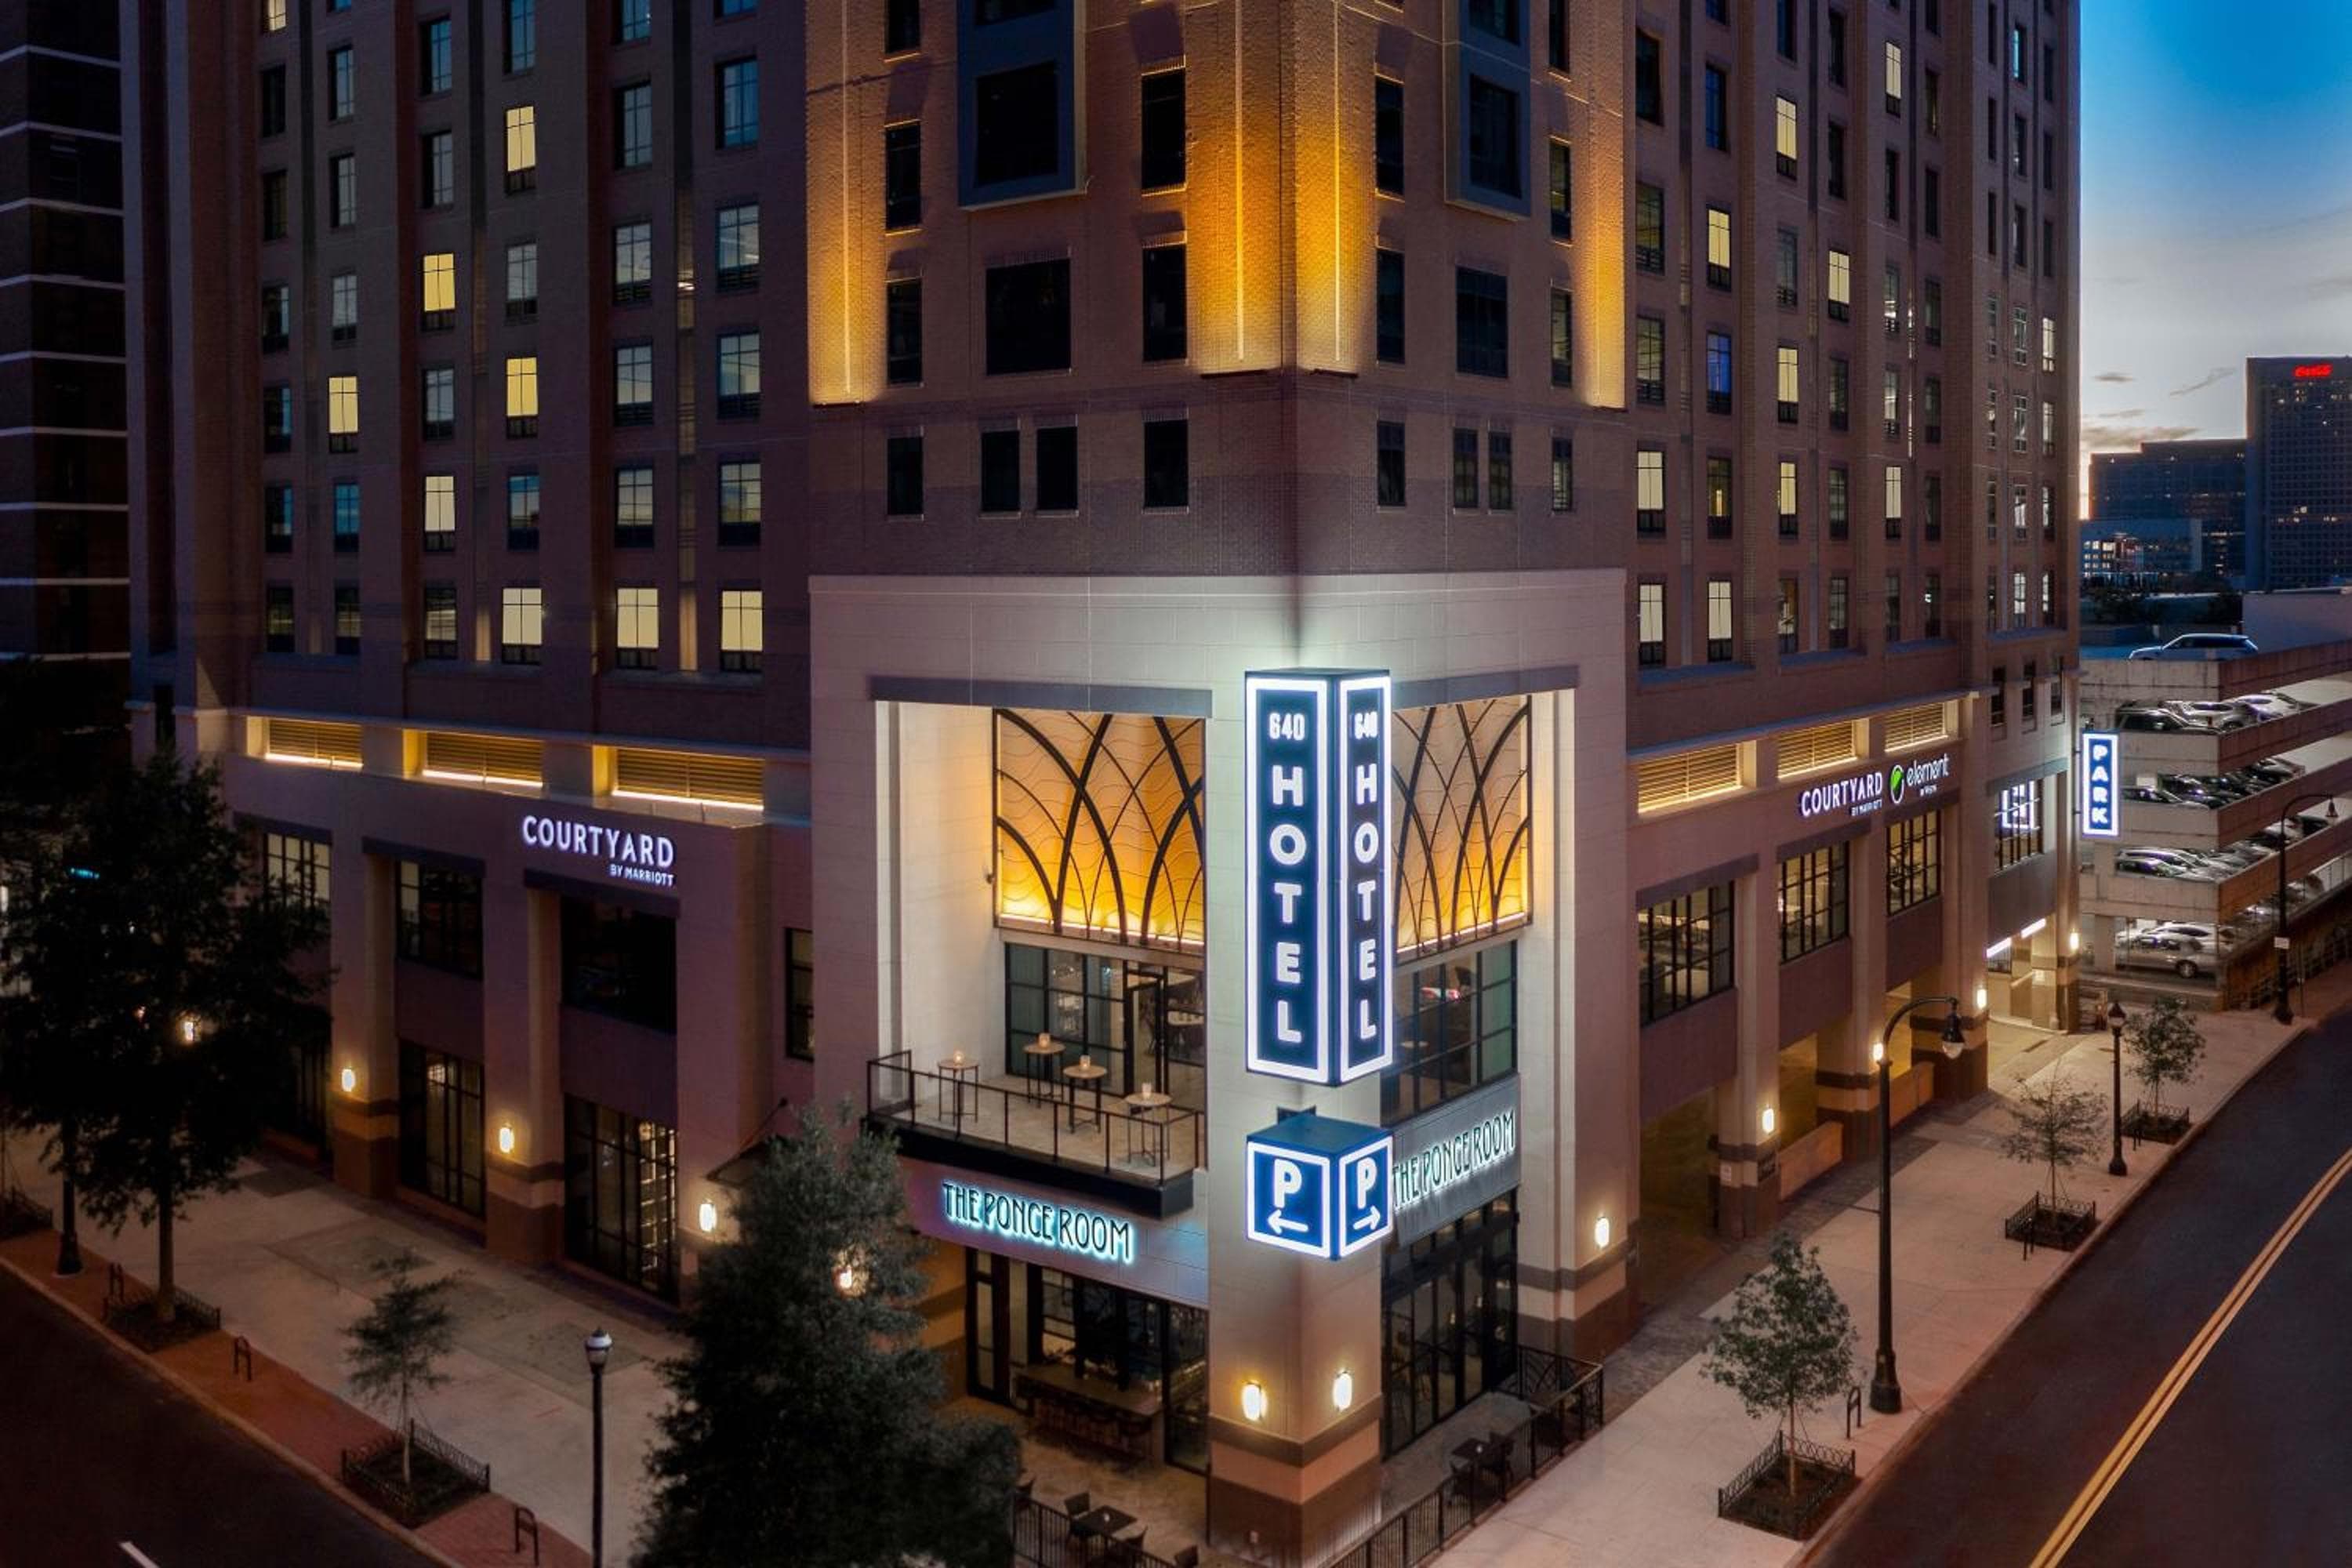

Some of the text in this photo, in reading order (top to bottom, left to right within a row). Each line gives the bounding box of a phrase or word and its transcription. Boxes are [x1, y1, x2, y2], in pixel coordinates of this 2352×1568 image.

[1269, 712, 1305, 741] 640
[1354, 711, 1378, 740] 640
[1801, 772, 1882, 817] COURTYARD
[1906, 753, 1950, 787] element
[2092, 744, 2109, 824] PARK
[522, 815, 674, 868] COURTYARD
[610, 864, 675, 887] BY MARRIOTT
[1354, 763, 1379, 1040] HOTEL
[1269, 765, 1307, 1044] HOTEL
[1274, 1158, 1303, 1209] P
[1356, 1156, 1377, 1210] P
[1392, 1108, 1515, 1208] THE PONCE ROOM
[942, 1182, 1131, 1260] THE PONCE ROOM
